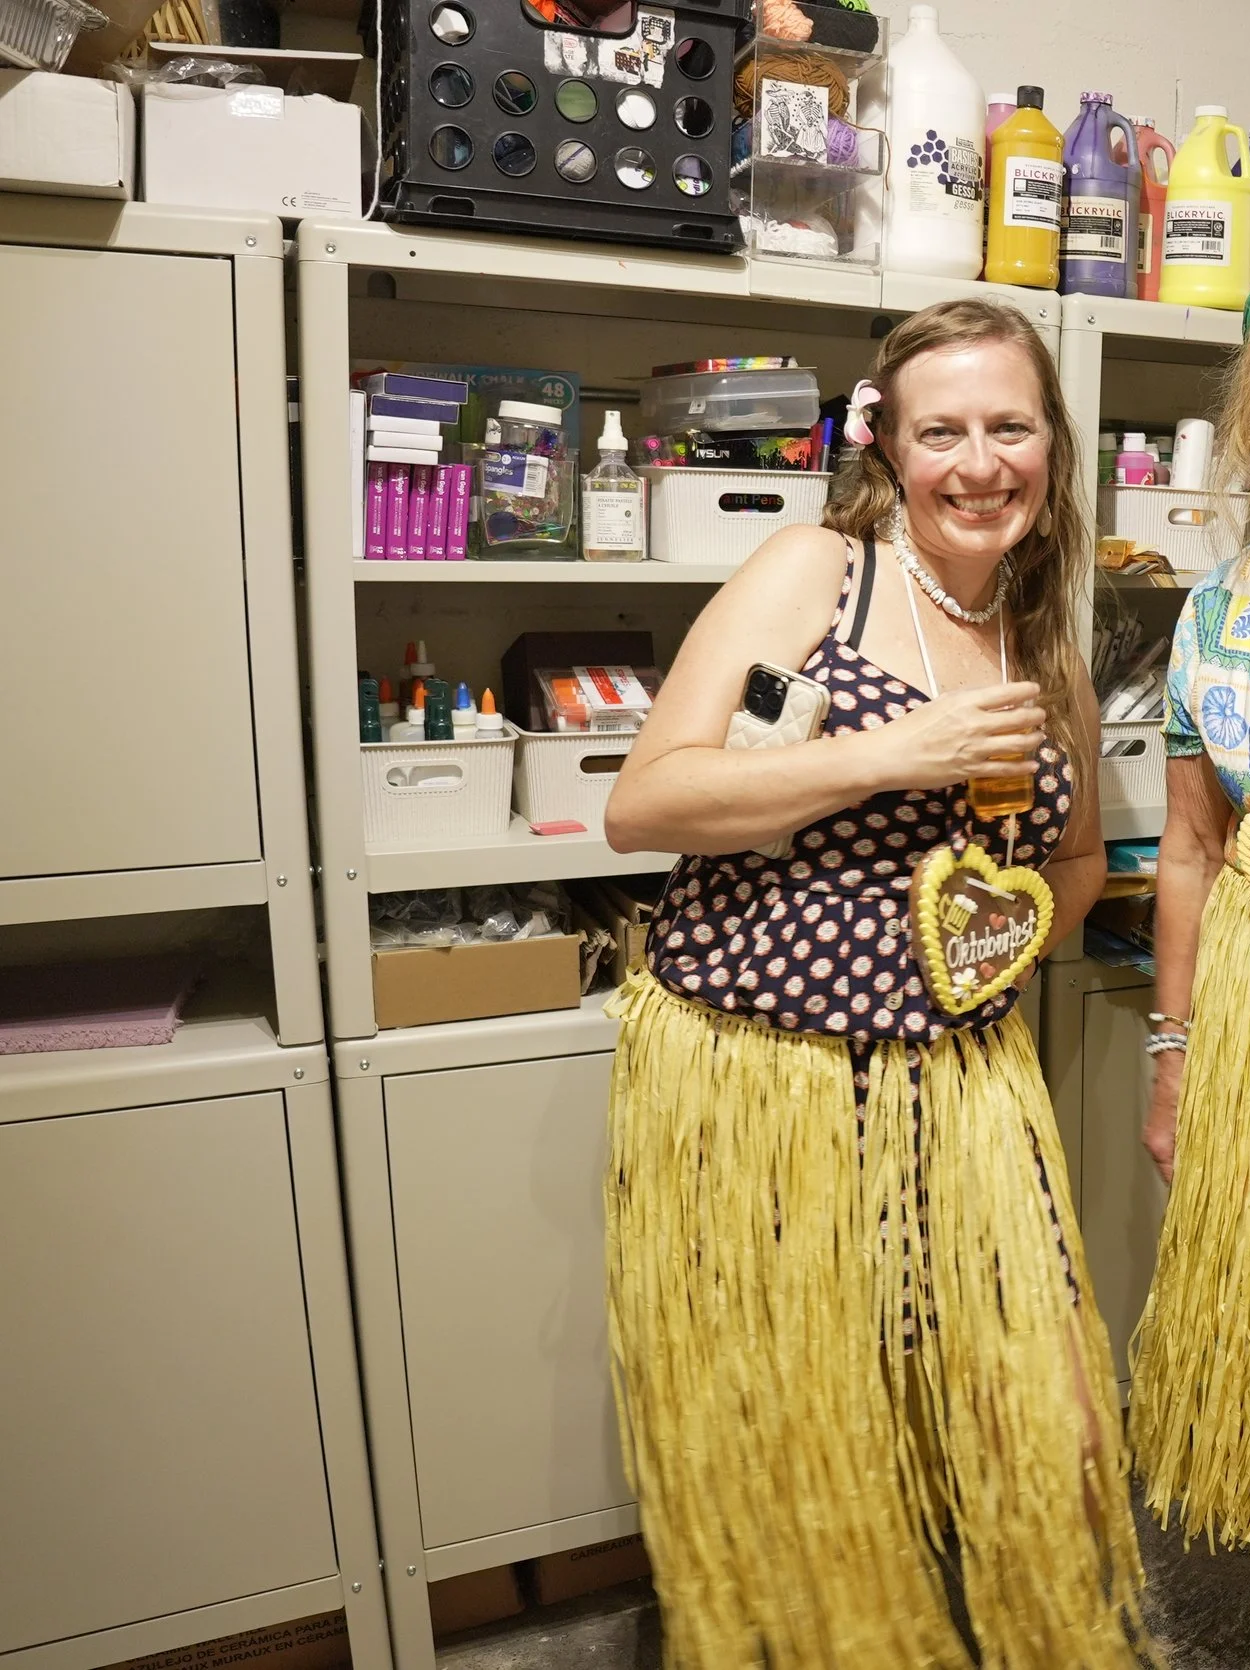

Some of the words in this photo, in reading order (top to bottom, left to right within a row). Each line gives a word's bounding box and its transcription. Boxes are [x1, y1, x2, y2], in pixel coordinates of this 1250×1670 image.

[952, 148, 978, 167] BASICS
[951, 163, 977, 176] ACRYLIC
[952, 183, 975, 199] GESSO
[954, 200, 974, 211] gesso
[542, 382, 565, 398] 48
[752, 494, 784, 506] Pens
[945, 908, 1036, 969] Oktoberfest
[197, 1648, 215, 1660] DE
[295, 1618, 330, 1635] PARA
[212, 1648, 273, 1668] MURAUX
[275, 1640, 294, 1650] EN
